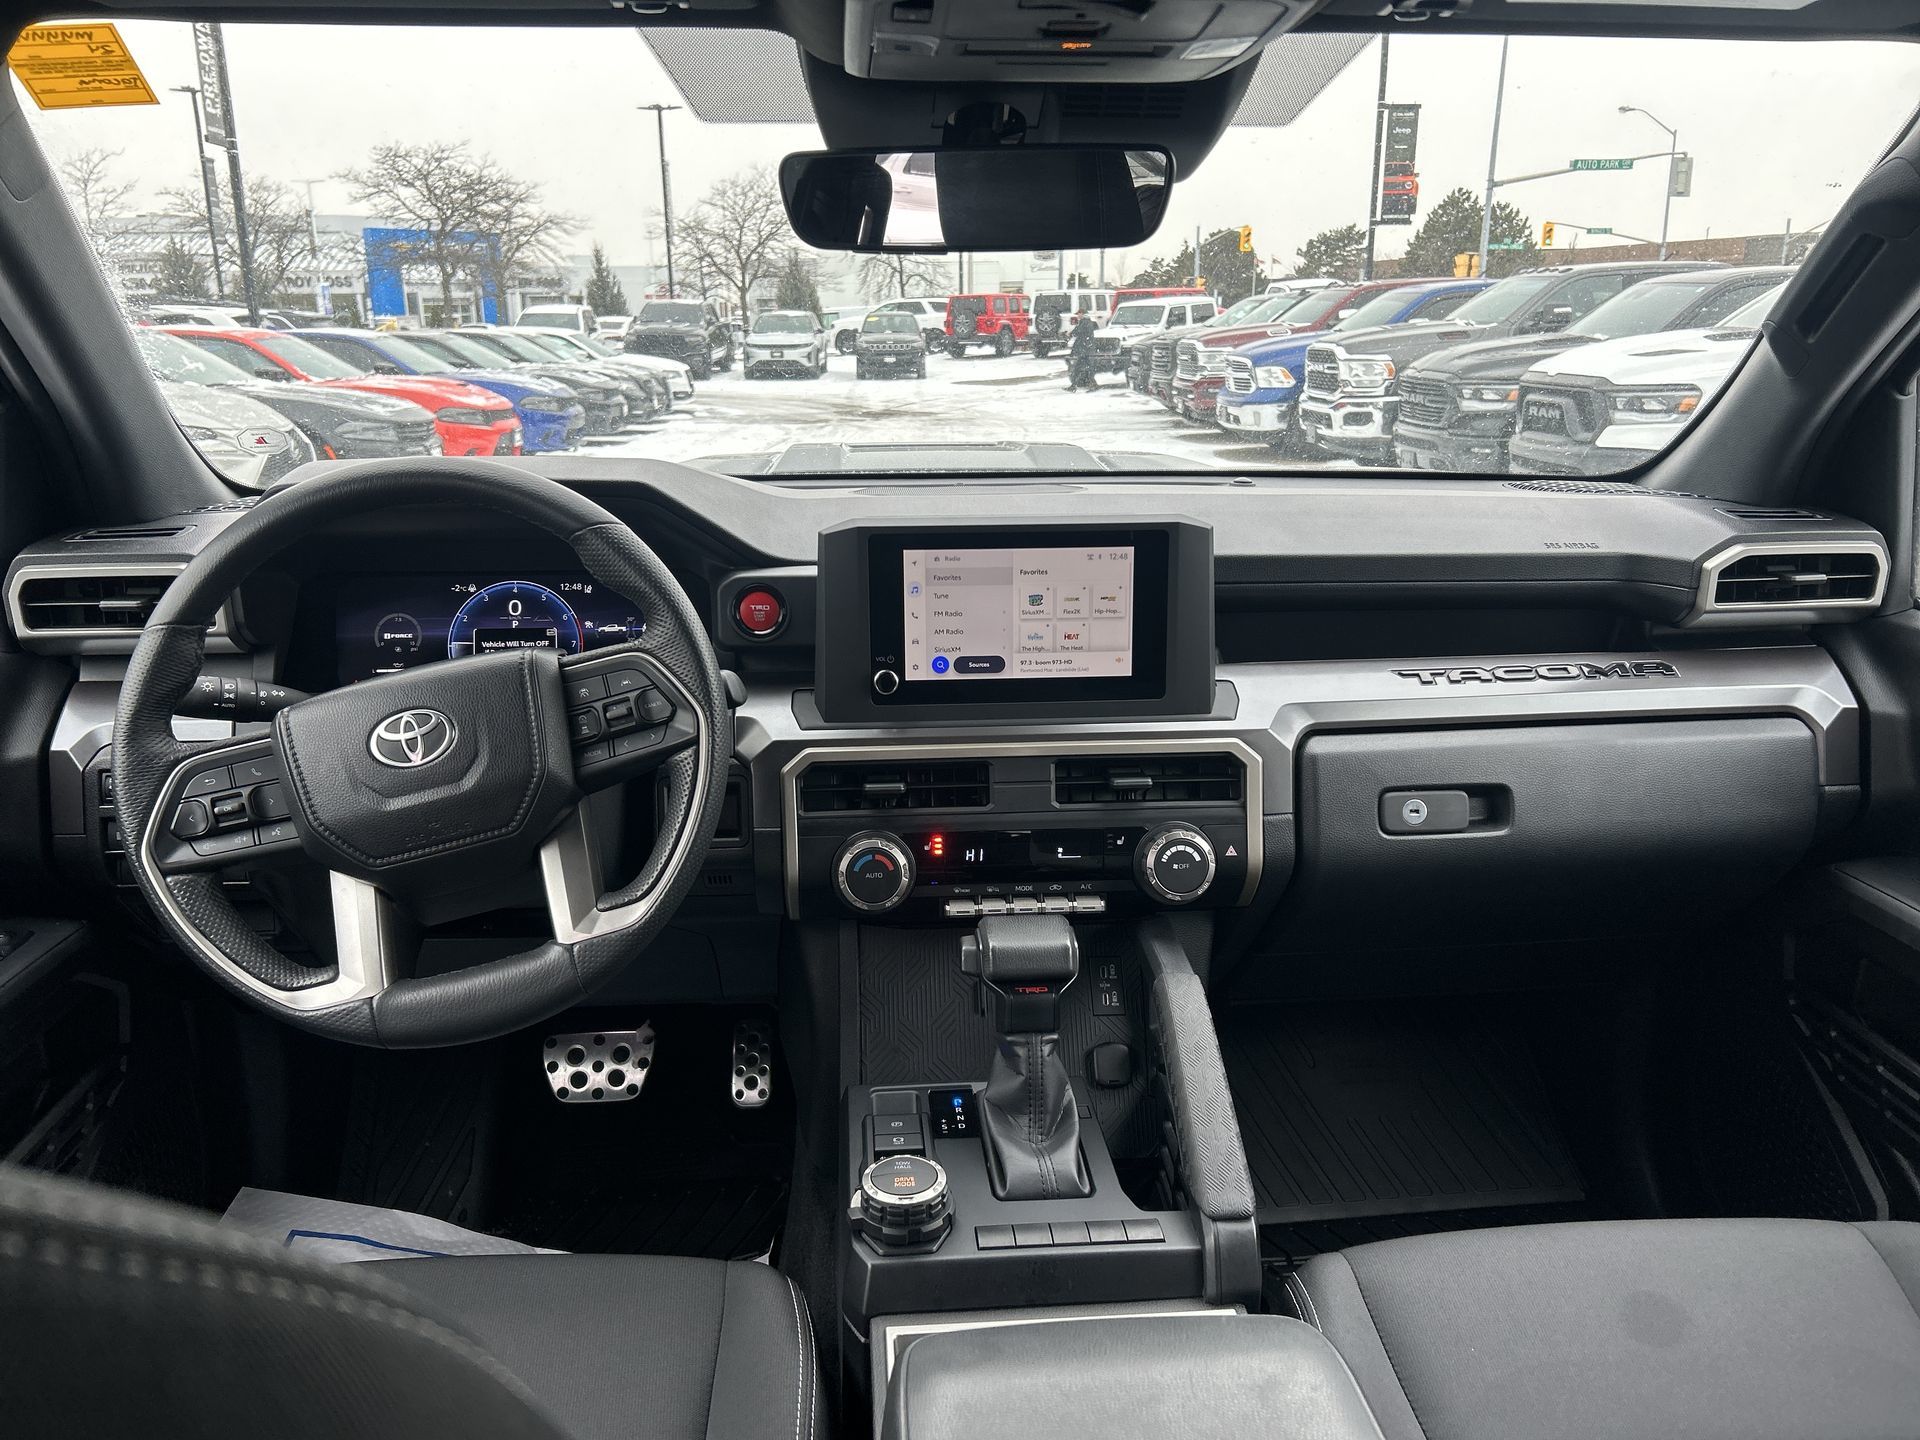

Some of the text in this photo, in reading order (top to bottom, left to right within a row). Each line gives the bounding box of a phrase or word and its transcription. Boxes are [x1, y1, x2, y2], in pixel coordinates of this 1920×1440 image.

[1393, 126, 1411, 135] Jeep
[1576, 160, 1598, 169] AUTO
[1600, 159, 1620, 169] PARK
[1528, 405, 1562, 420] RAM
[1019, 568, 1048, 576] Favorites
[933, 574, 962, 582] Favorites
[560, 583, 583, 591] 12:48
[508, 599, 522, 616] 0
[512, 620, 519, 629] P
[1063, 633, 1080, 641] HEAT
[571, 640, 577, 648] 7
[1396, 659, 1681, 686] TACOMA
